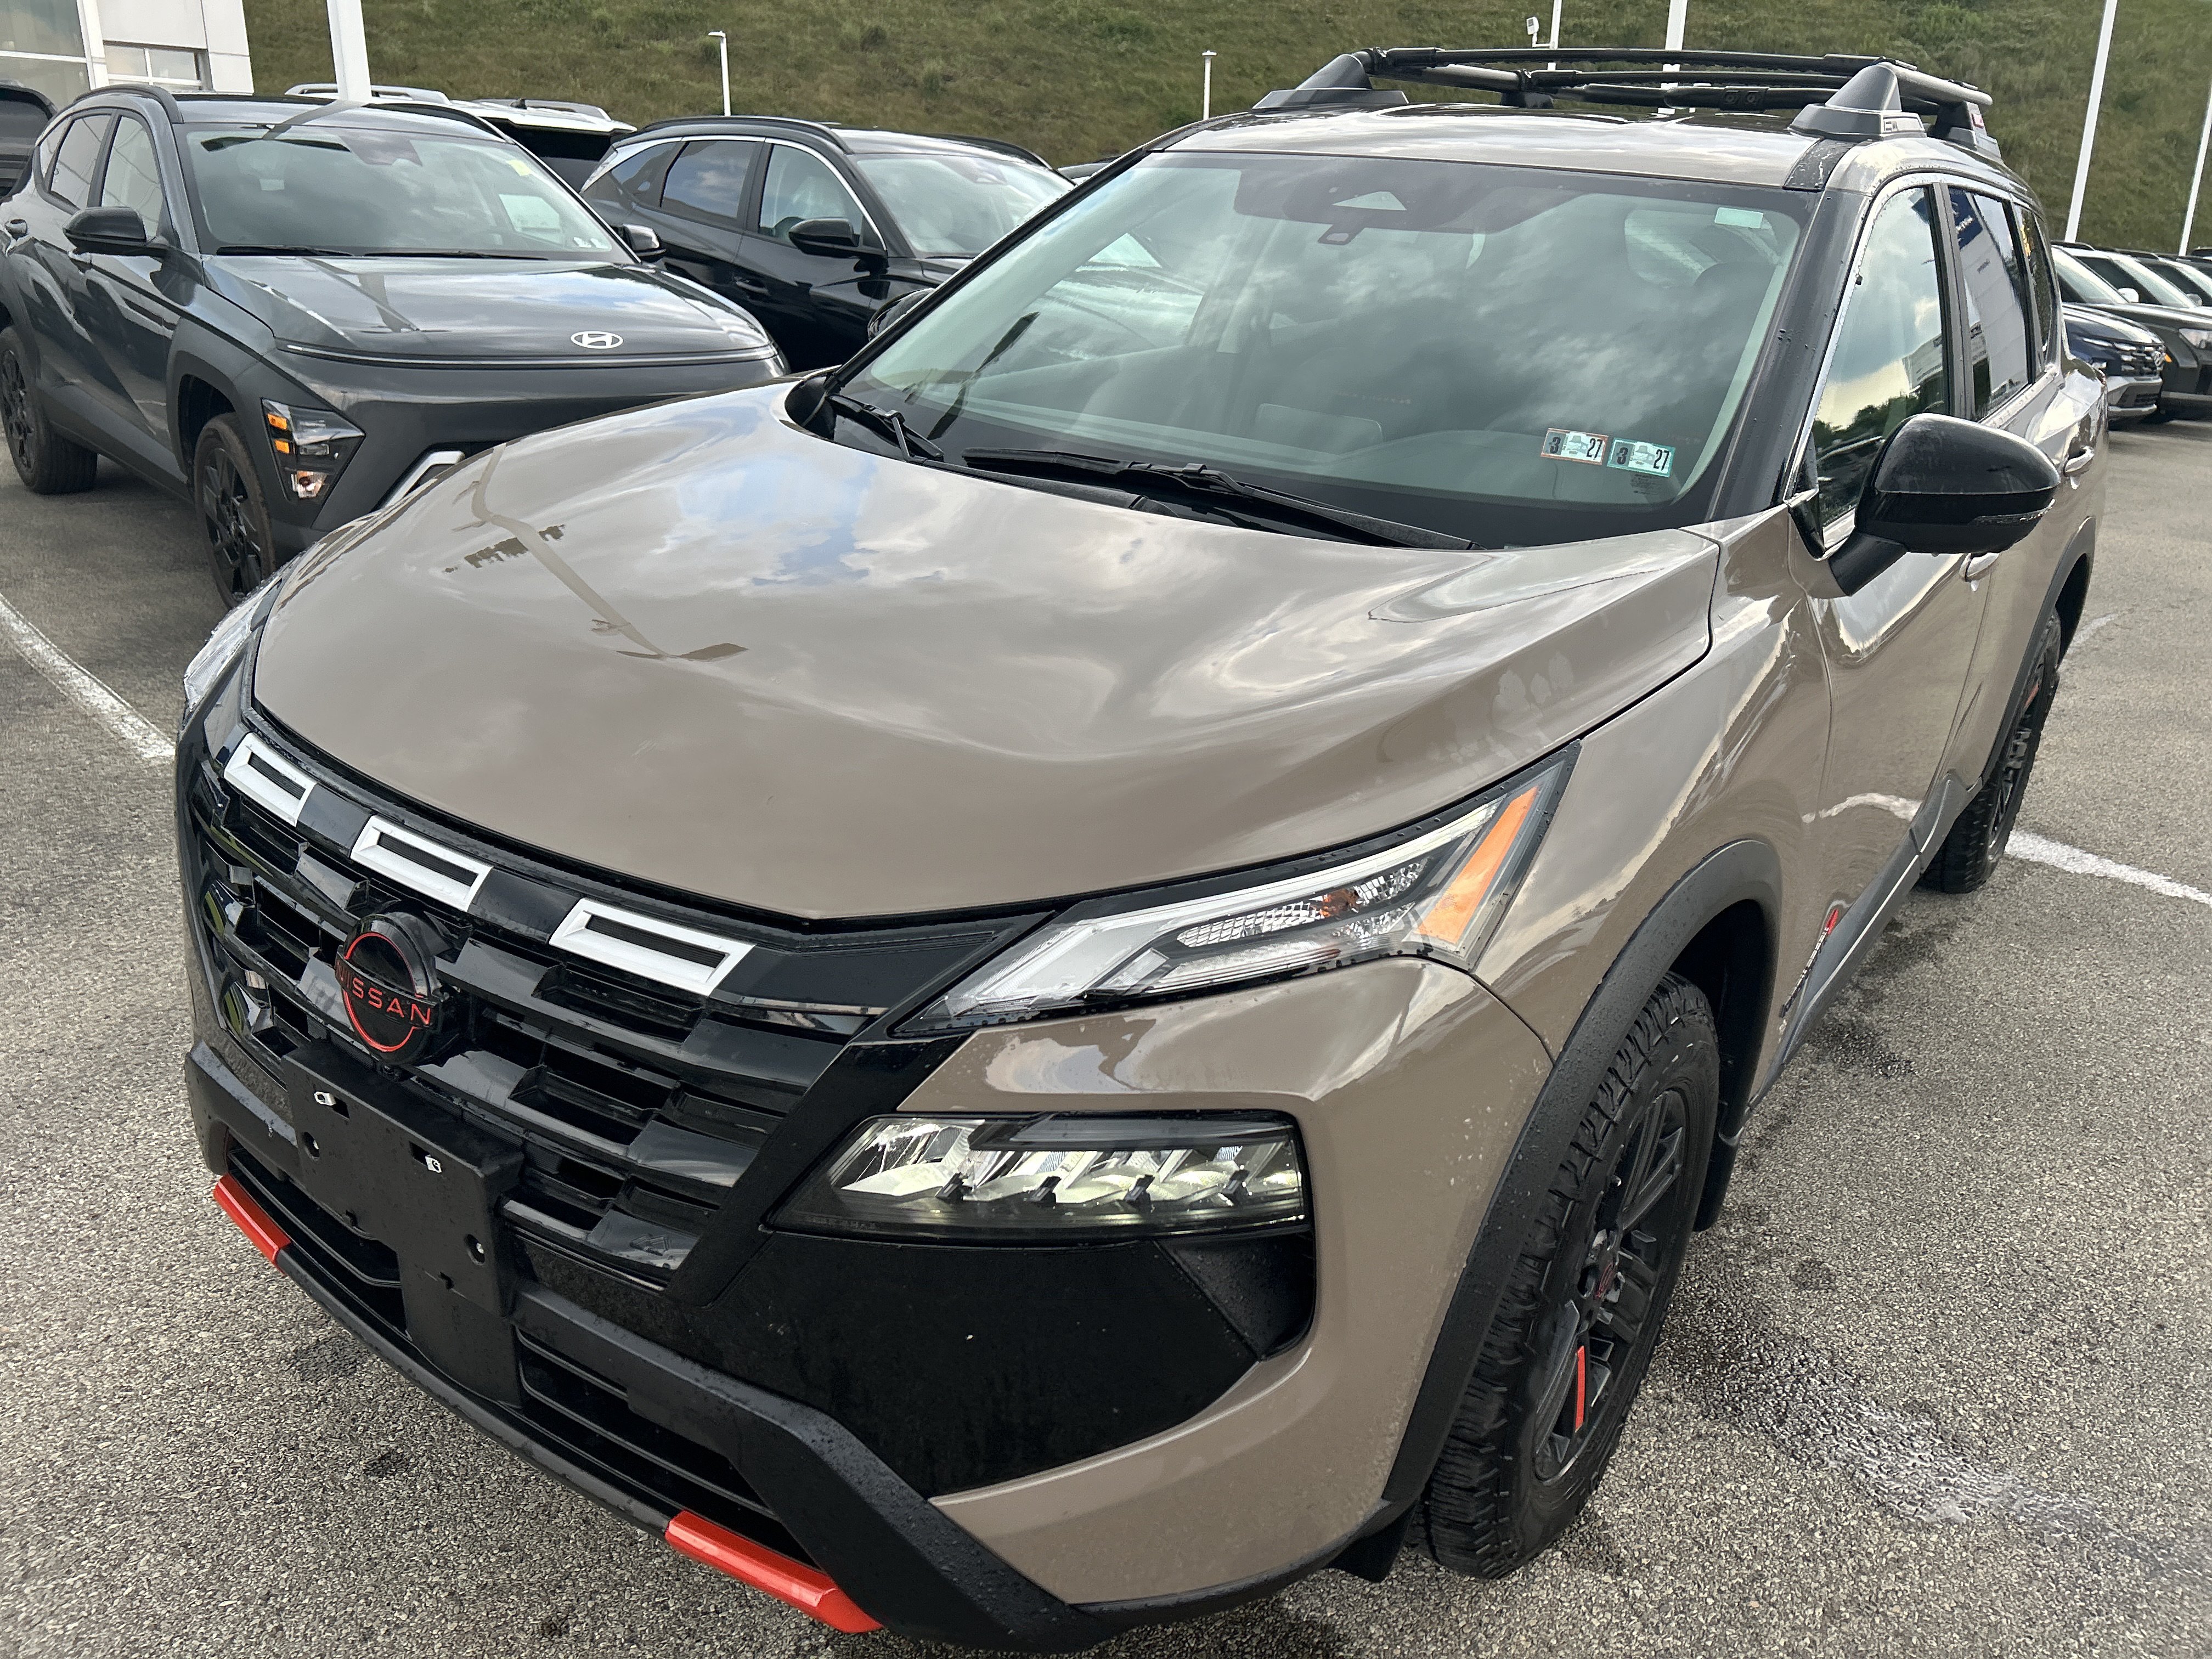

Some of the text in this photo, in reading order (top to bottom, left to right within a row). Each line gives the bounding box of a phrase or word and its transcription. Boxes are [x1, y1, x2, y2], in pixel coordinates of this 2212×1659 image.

[1550, 437, 1602, 459] 3 27
[1617, 447, 1669, 470] 3 27
